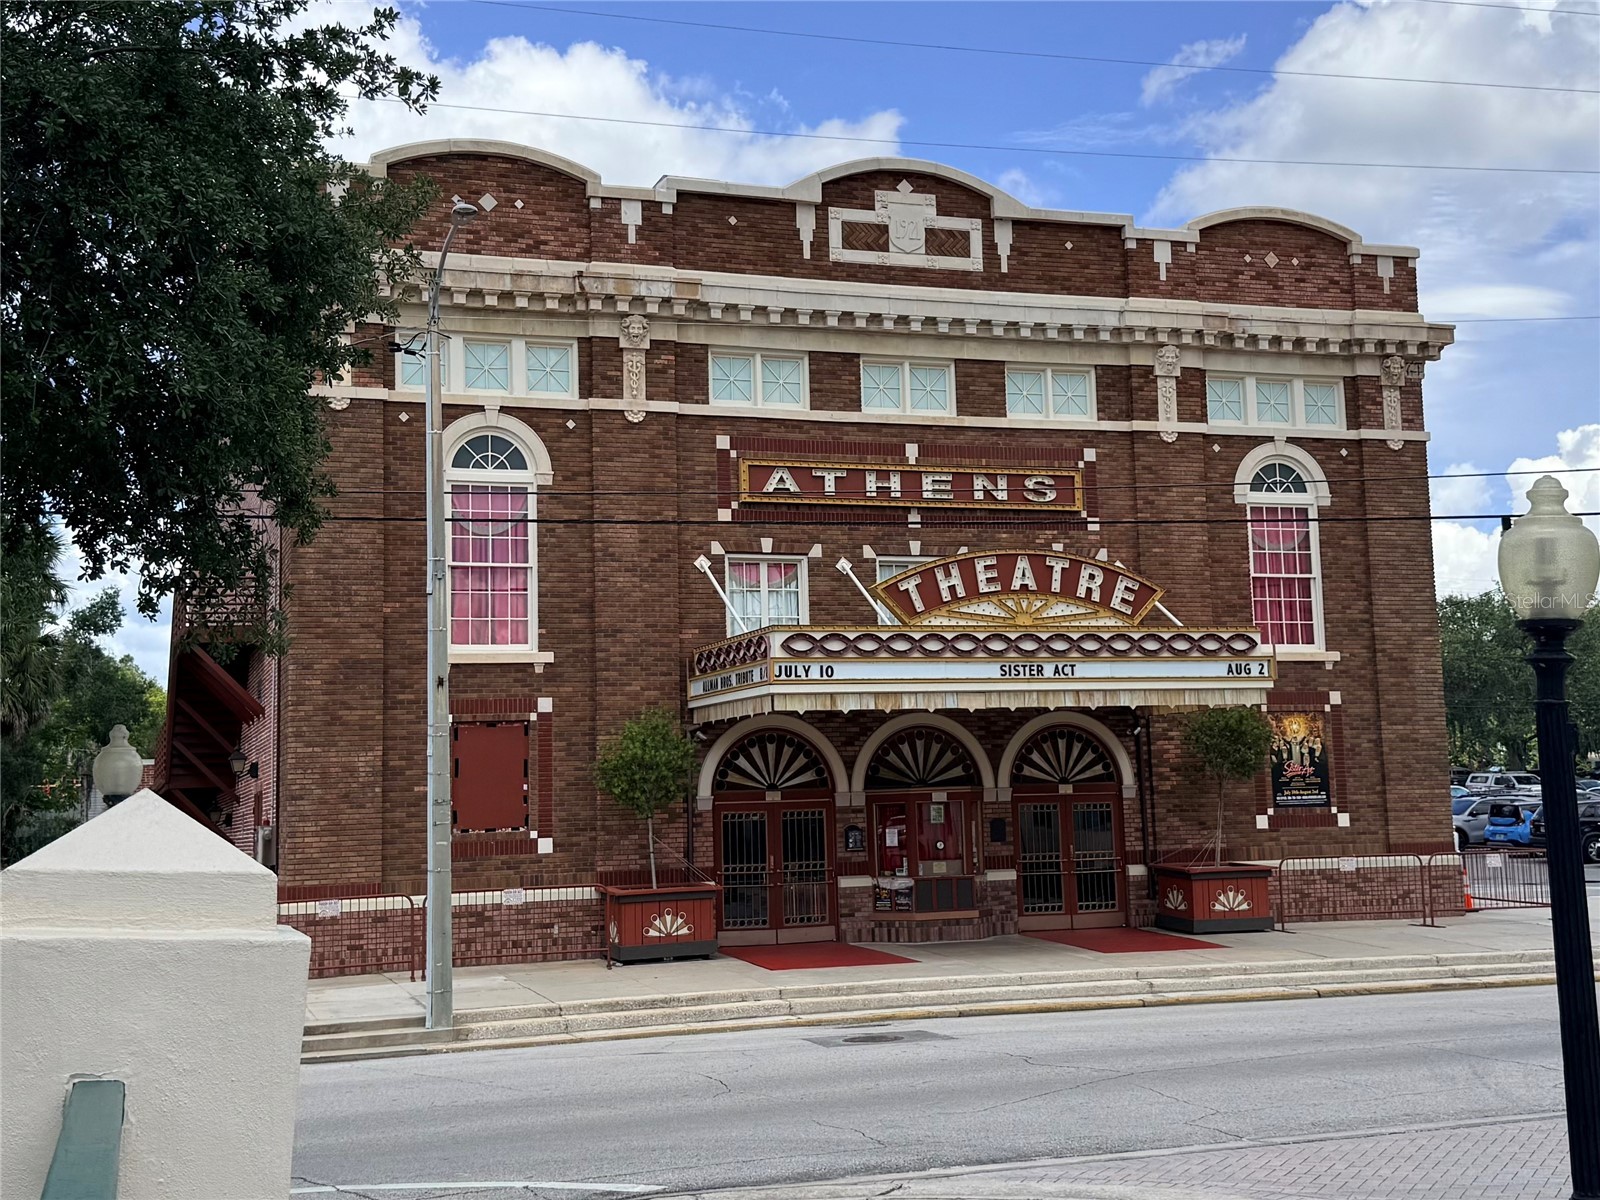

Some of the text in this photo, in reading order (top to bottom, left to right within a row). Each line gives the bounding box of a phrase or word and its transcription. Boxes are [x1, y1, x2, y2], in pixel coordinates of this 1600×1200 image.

[762, 467, 1058, 502] ATHENS
[897, 555, 1140, 615] THEATRE
[774, 664, 835, 679] JULY 10
[999, 664, 1077, 677] SISTER ACT
[1226, 662, 1265, 676] AUG 2
[720, 674, 734, 690] BROS.
[735, 669, 754, 687] TRIBUTE
